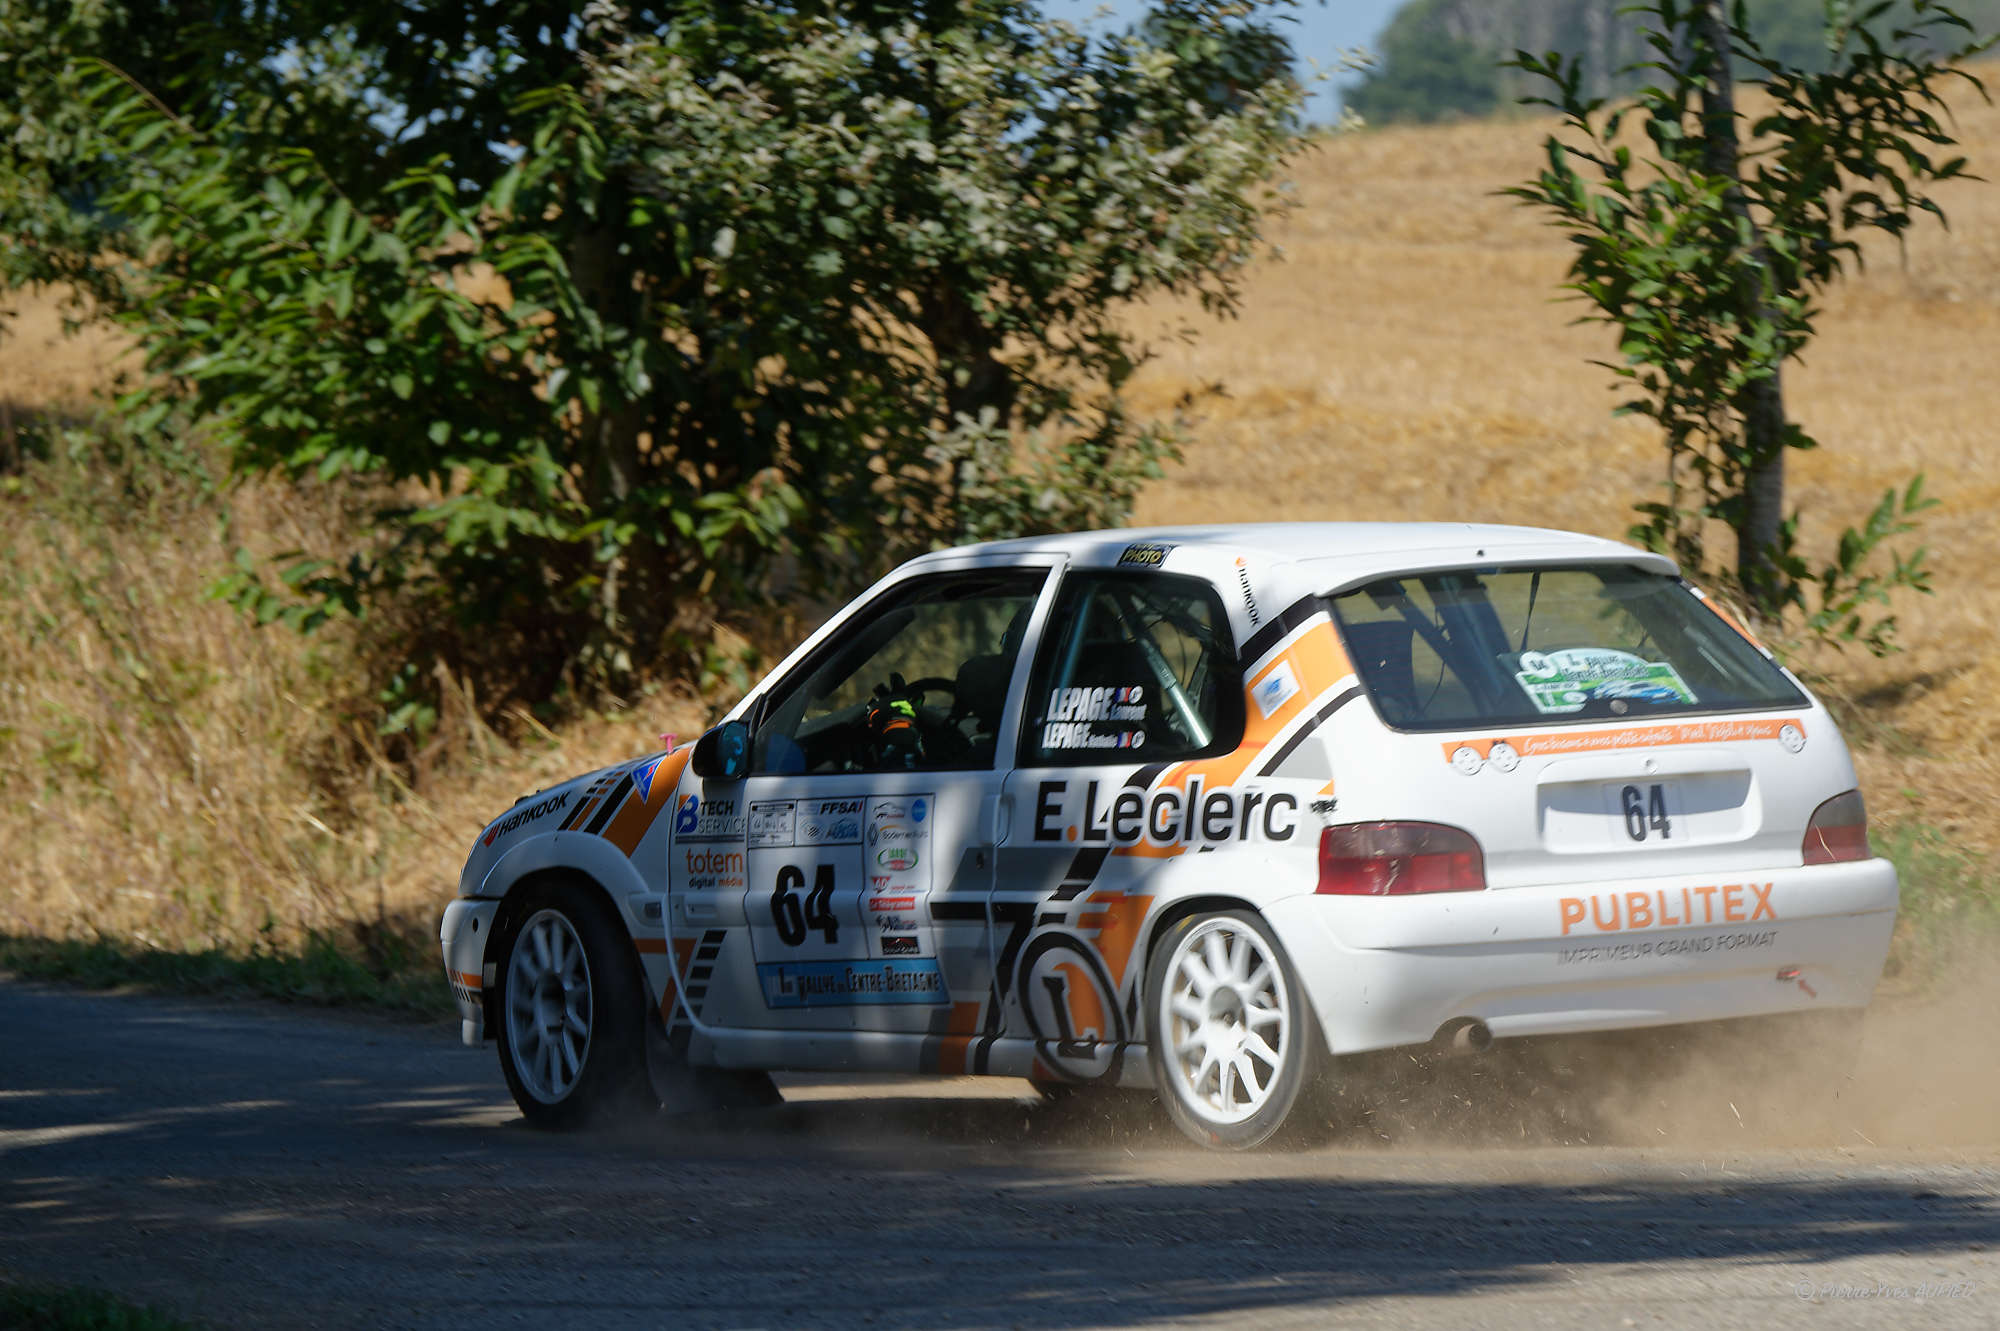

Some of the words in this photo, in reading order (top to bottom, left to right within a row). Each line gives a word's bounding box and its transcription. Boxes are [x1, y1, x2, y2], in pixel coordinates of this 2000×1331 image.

[1122, 549, 1163, 563] PHOTO
[1046, 687, 1115, 721] LEPAGE
[1042, 722, 1092, 748] LEPAGE
[700, 800, 734, 816] TECH
[819, 802, 857, 816] FFSA
[1034, 779, 1297, 842] E.Leclerc
[1621, 785, 1671, 841] 64
[686, 848, 743, 874] totem
[689, 877, 715, 890] digital
[770, 864, 839, 947] 64
[1558, 882, 1777, 935] PUBLITEX
[1558, 942, 1653, 966] IMPRIMEUR
[1655, 937, 1714, 957] GRAND
[1715, 931, 1779, 951] FORMAT
